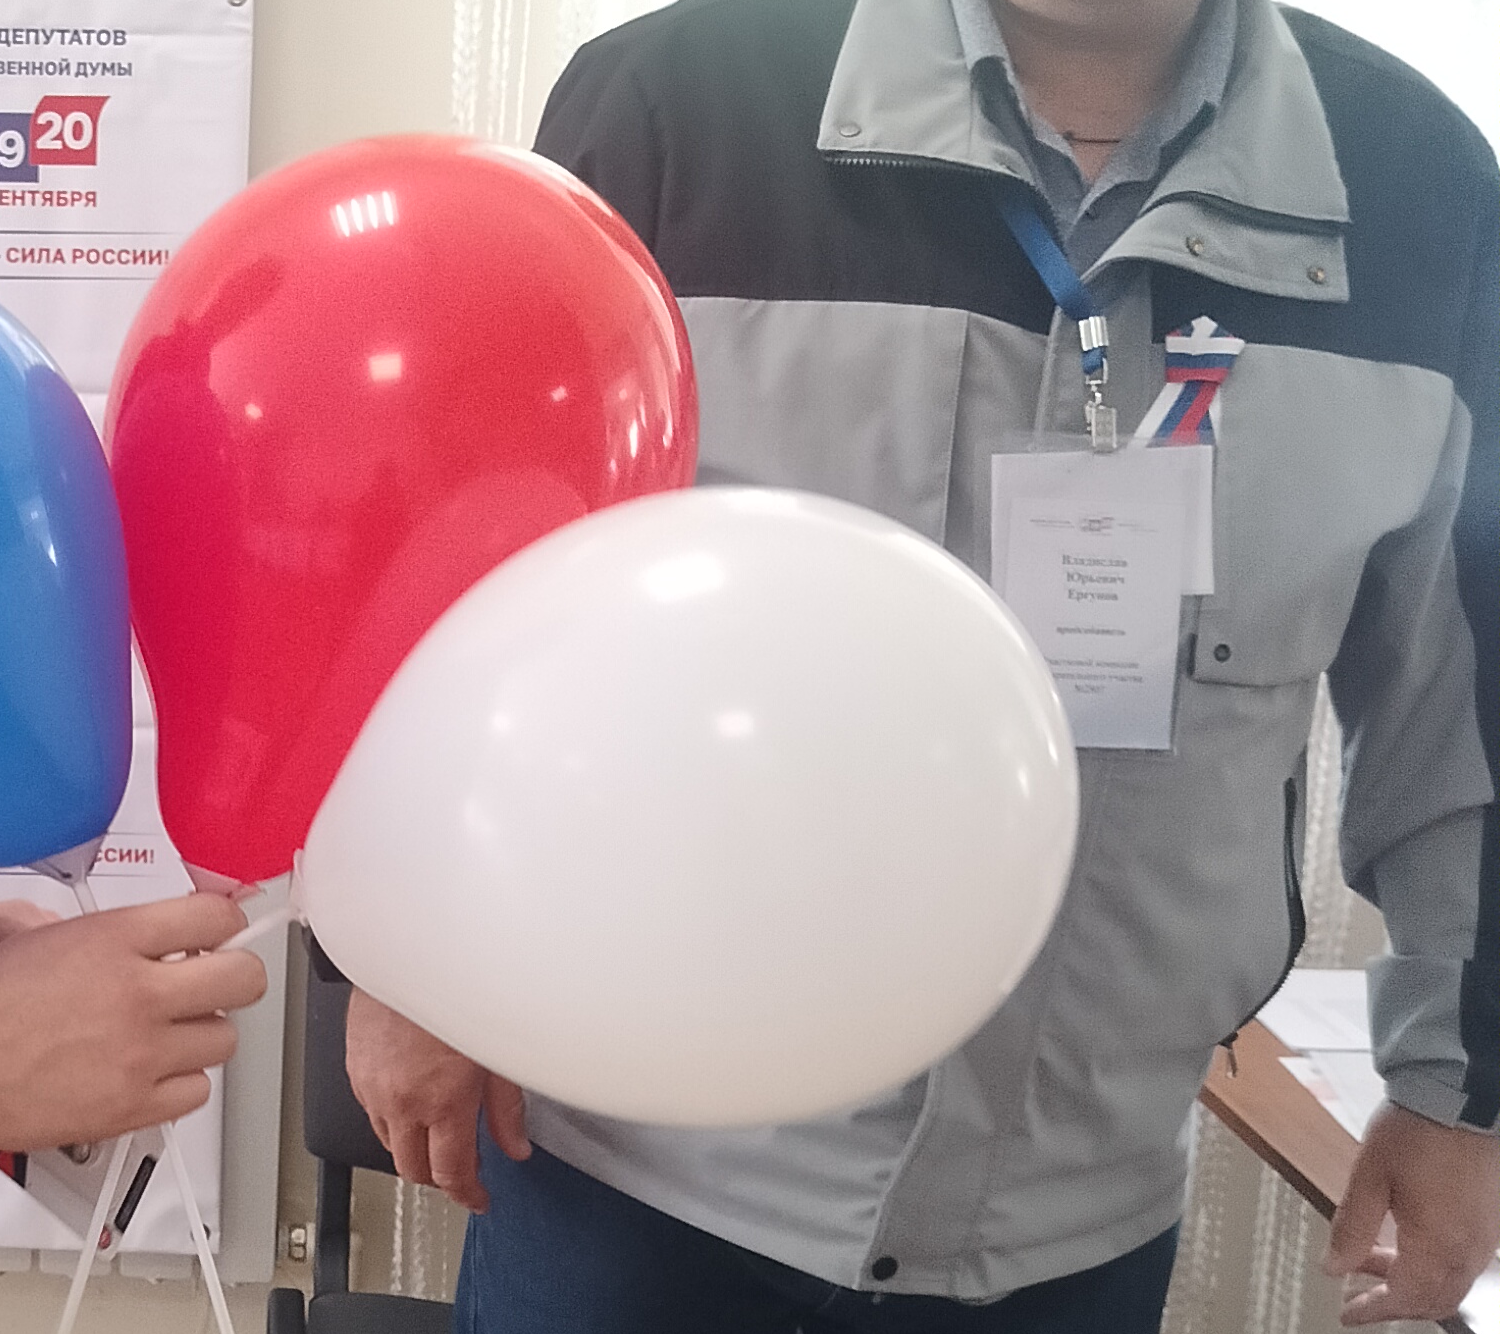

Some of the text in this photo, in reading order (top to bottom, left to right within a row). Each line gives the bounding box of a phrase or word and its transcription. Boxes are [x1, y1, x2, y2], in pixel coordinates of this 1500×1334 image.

[75, 62, 132, 77] ДУМЫ
[36, 112, 93, 150] 20
[6, 247, 65, 264] СИЛА
[72, 248, 170, 266] РОССИИ!
[96, 848, 154, 864] СИИ!
